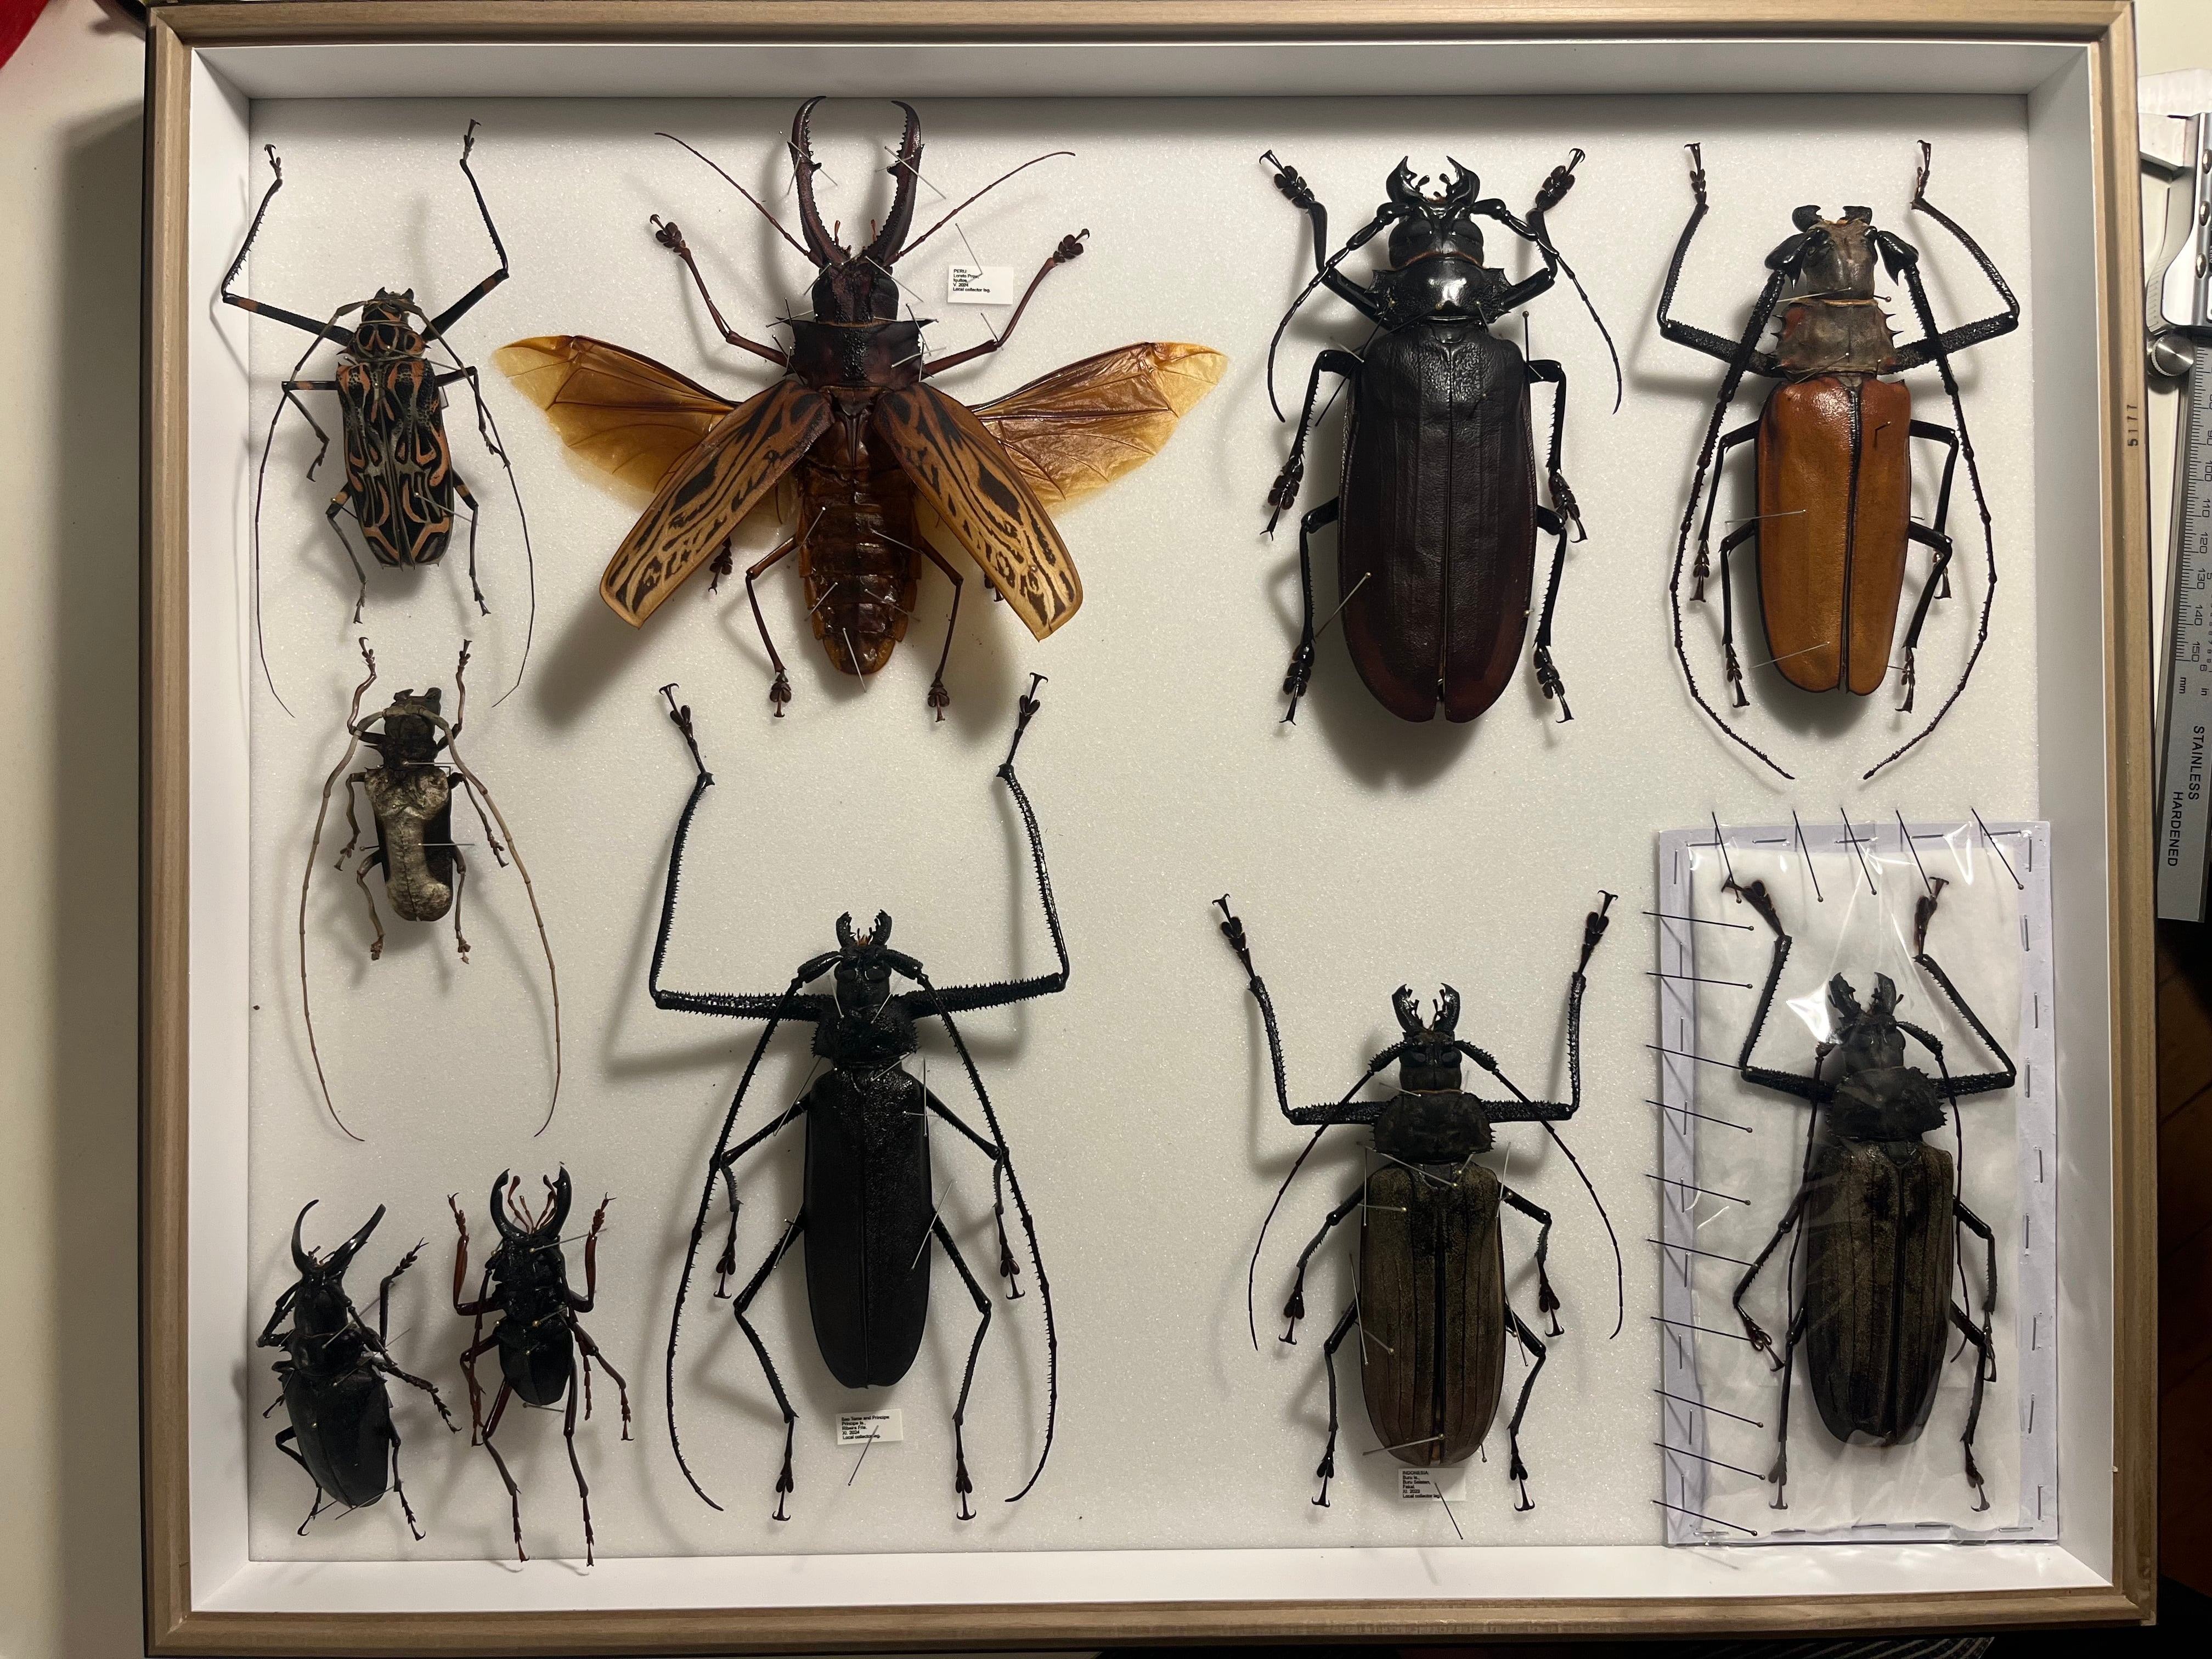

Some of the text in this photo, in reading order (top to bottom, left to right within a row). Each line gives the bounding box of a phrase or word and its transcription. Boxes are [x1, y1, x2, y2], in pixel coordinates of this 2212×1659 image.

[2126, 404, 2138, 447] 5177
[2202, 498, 2210, 517] 110
[2200, 532, 2208, 554] 120
[2197, 567, 2205, 589] 130
[2194, 604, 2203, 625] 140
[2192, 641, 2200, 662] 150
[2179, 677, 2186, 694] mm
[2188, 725, 2205, 800] STAINLESS
[2168, 791, 2183, 867] HARDENED
